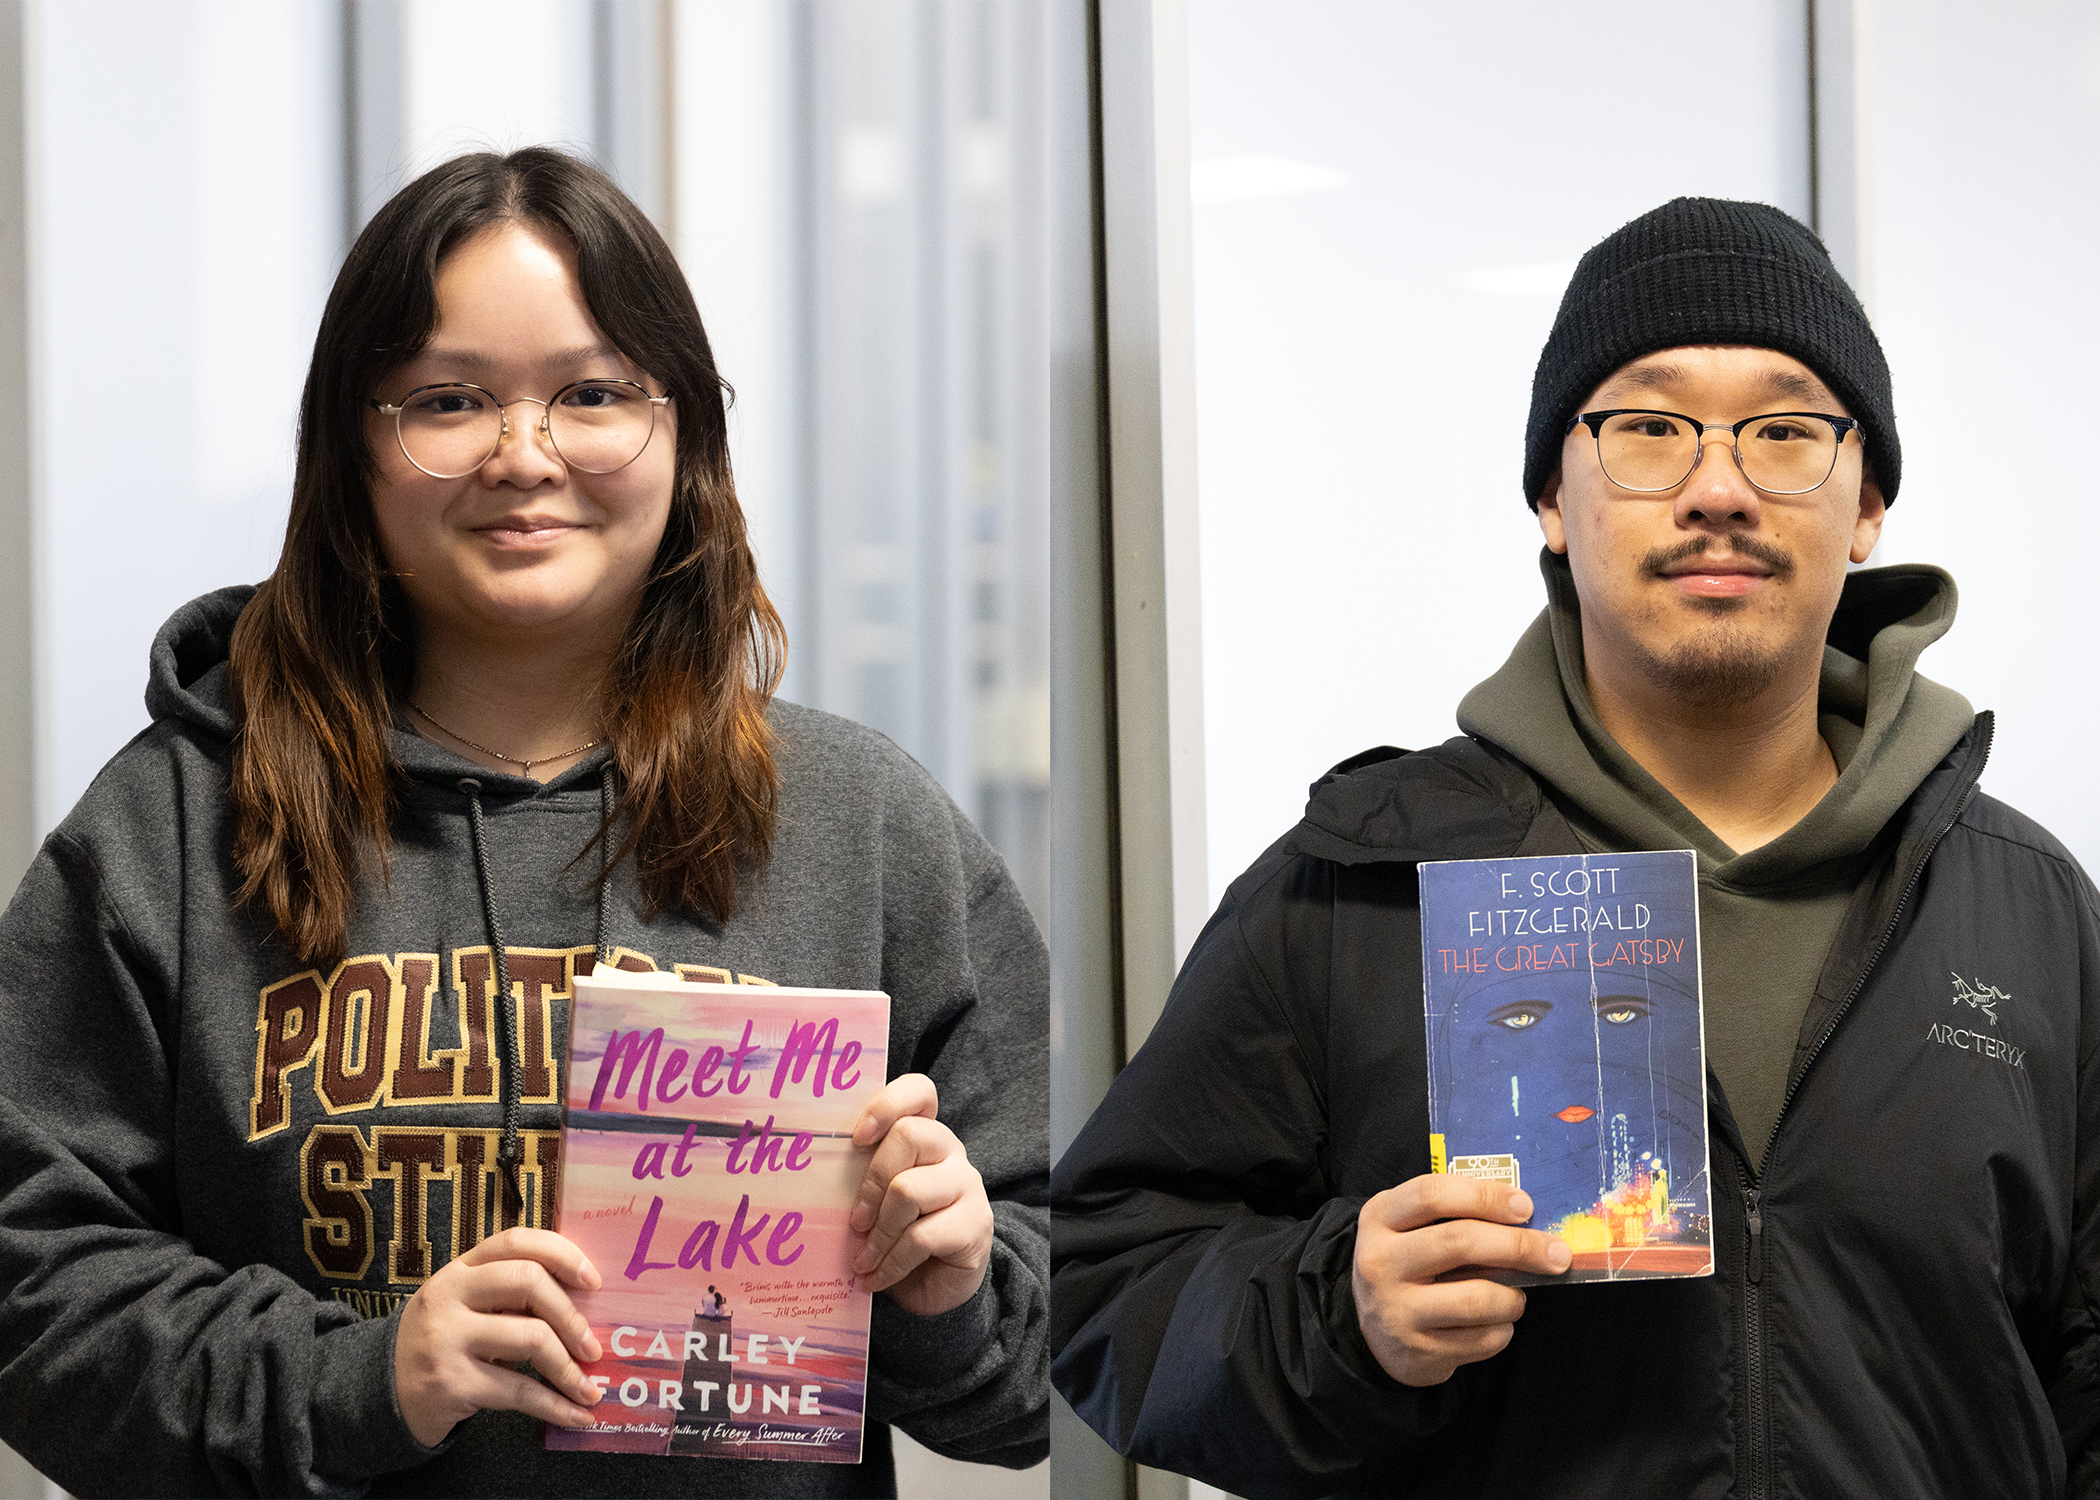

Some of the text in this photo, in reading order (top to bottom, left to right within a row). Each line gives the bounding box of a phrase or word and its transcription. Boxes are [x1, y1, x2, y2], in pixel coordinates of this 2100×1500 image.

[1501, 867, 1620, 899] F. SCOTT
[1469, 903, 1651, 937] FITZGERALD
[1438, 938, 1685, 974] THE GREAT GATSBY
[1926, 1022, 2027, 1070] ARC'TERYX
[588, 1017, 863, 1112] Meet Me
[632, 1115, 814, 1180] at the
[583, 1194, 637, 1220] a novel
[624, 1194, 805, 1282] Lake
[774, 1280, 795, 1290] with
[796, 1279, 809, 1289] the
[812, 1278, 844, 1288] warmth
[847, 1277, 856, 1288] of
[791, 1304, 833, 1319] Santopolo
[610, 1326, 806, 1365] CARLEY
[600, 1420, 622, 1432] Times
[624, 1422, 669, 1438] Bestselling
[672, 1424, 700, 1436] Author
[702, 1427, 711, 1441] of
[713, 1423, 751, 1446] Every
[755, 1423, 810, 1441] Summer
[811, 1427, 846, 1445] After
